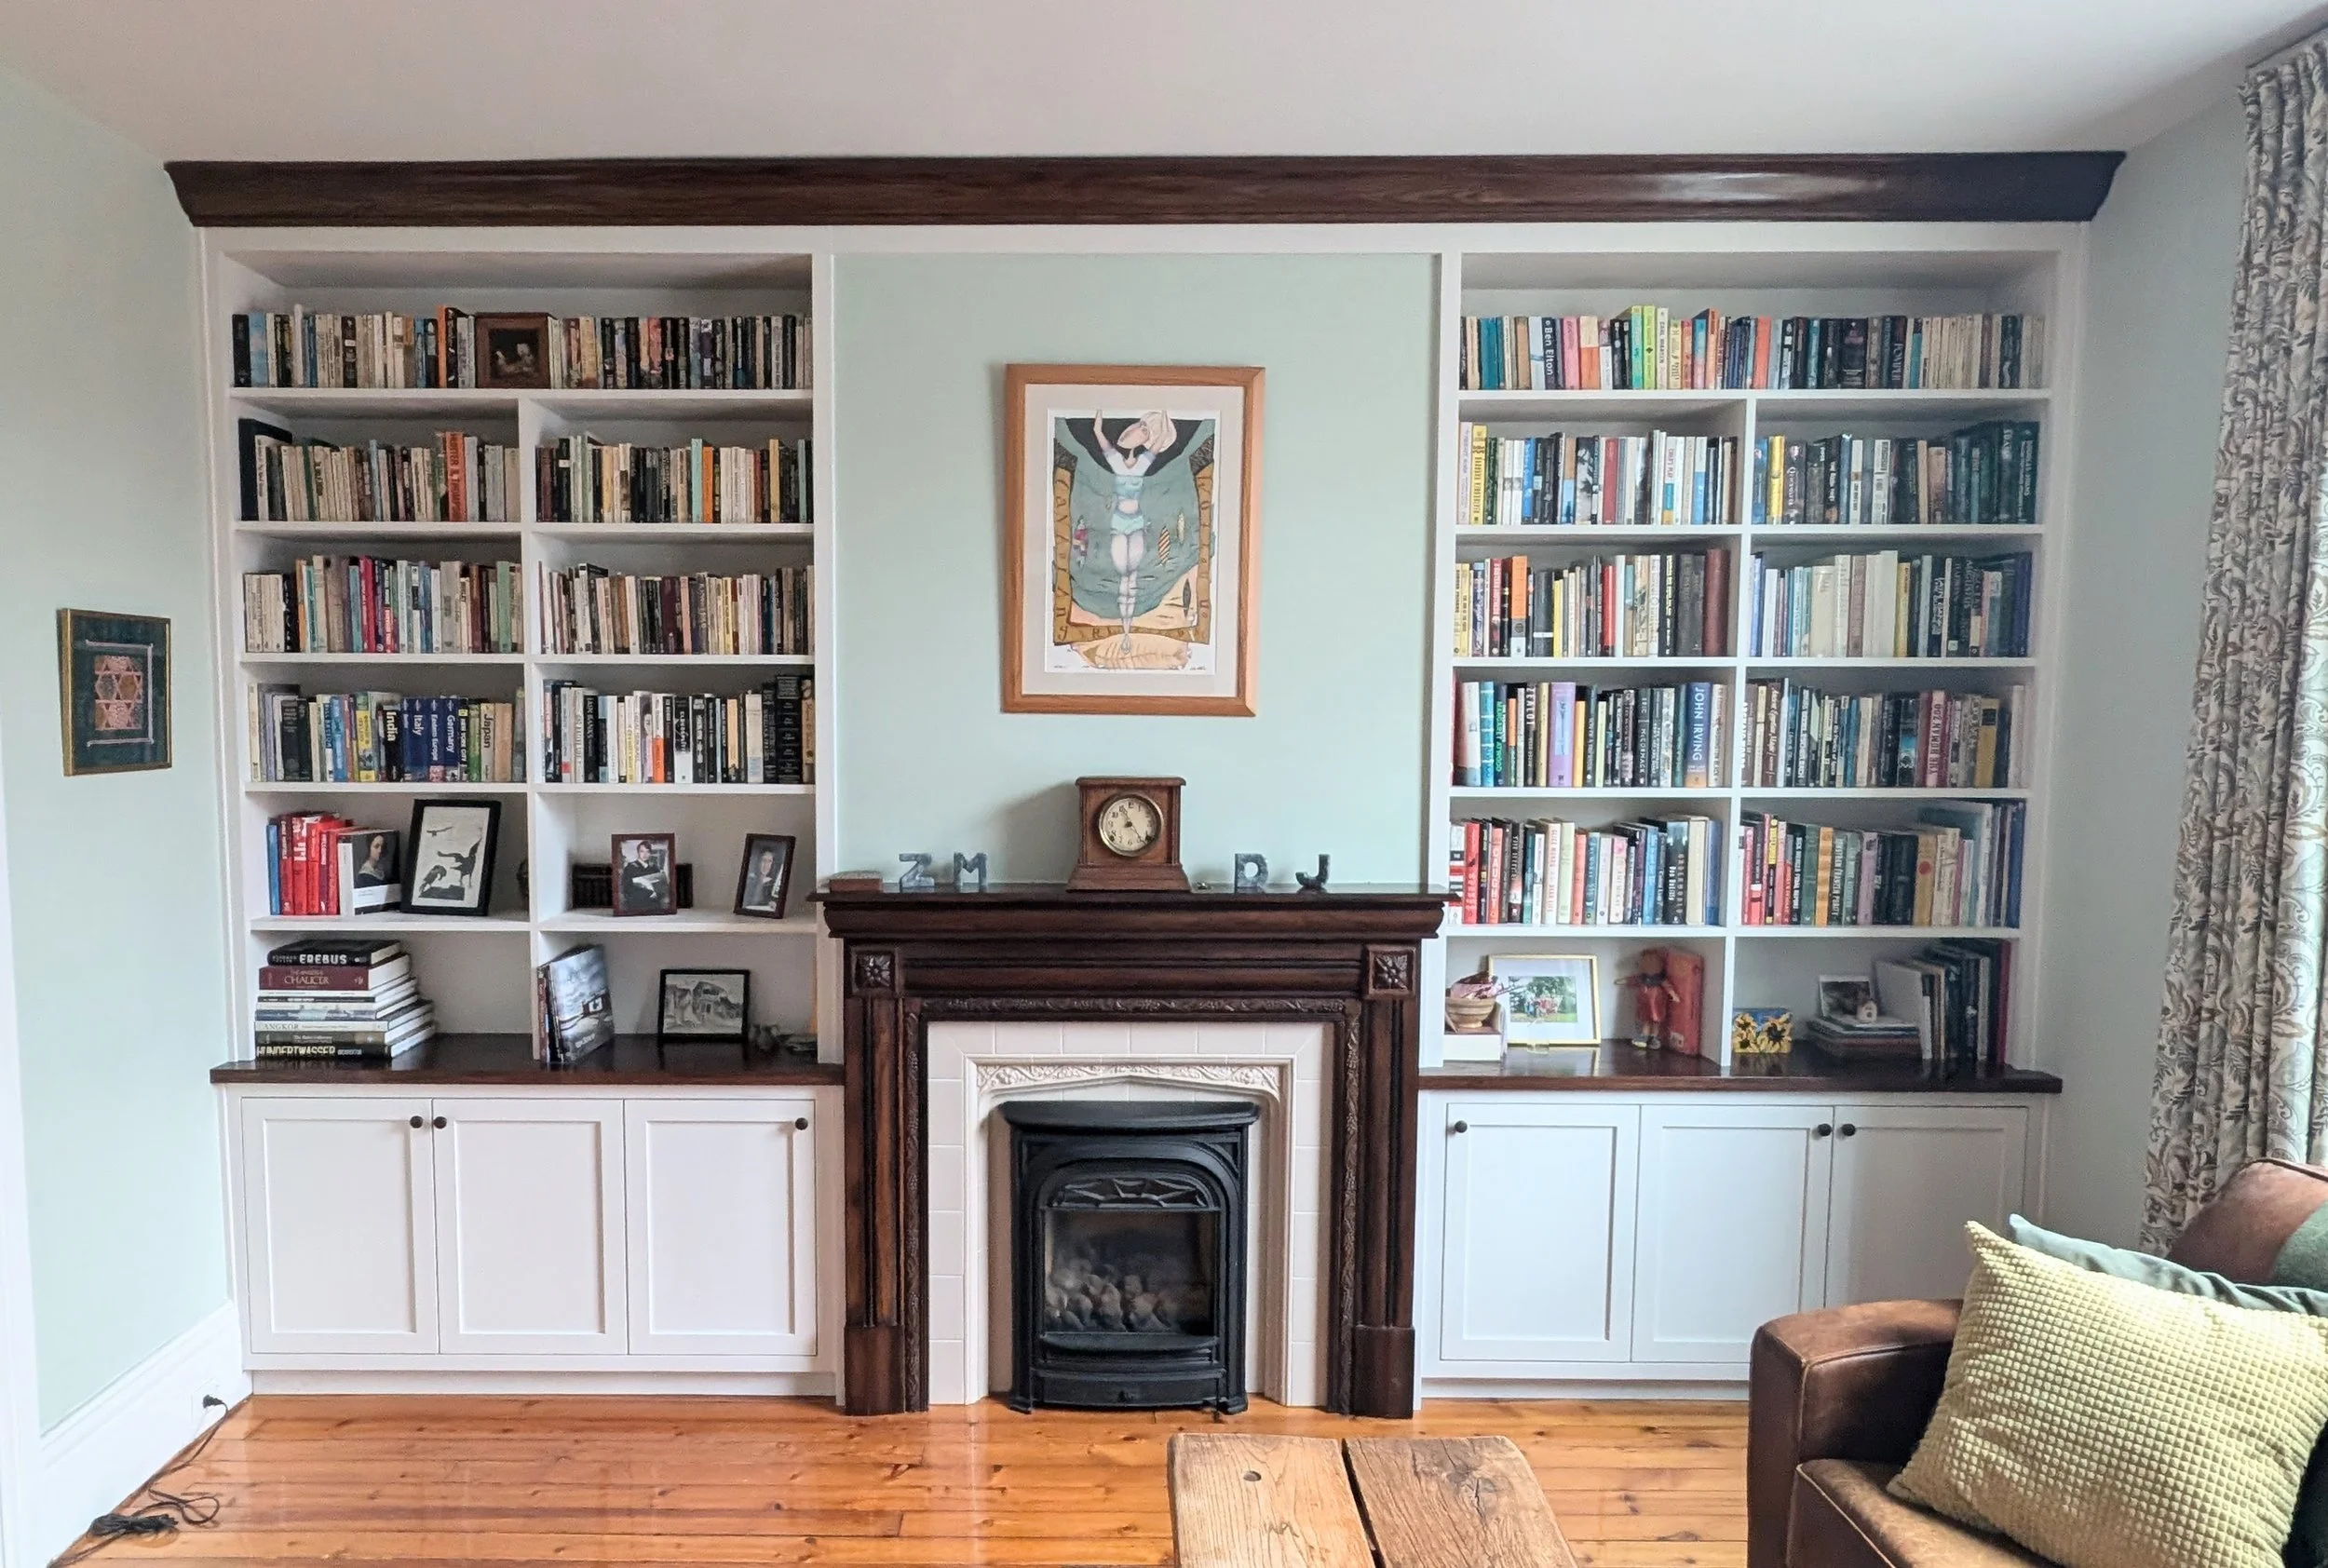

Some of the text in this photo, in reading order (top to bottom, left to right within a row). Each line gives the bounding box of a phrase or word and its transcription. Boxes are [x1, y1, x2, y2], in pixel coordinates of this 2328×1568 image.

[1544, 327, 1555, 375] Ben Elton
[450, 434, 459, 466] HUNTER
[1526, 687, 1536, 726] ZEALOT
[387, 711, 398, 741] India
[412, 714, 423, 736] Italy
[446, 715, 455, 753] Germany
[481, 713, 494, 749] Japan
[1692, 687, 1705, 761] JOHN IRVING
[1928, 703, 1942, 775] THE HUMAN ZOO
[899, 853, 987, 891] Z M
[1295, 854, 1330, 887] J
[1669, 866, 1677, 877] Don
[1676, 854, 1685, 914] UNDERWORLD
[1834, 869, 1843, 894] FRANZEN
[1832, 896, 1840, 916] PURITY
[299, 953, 347, 965] EREBUS
